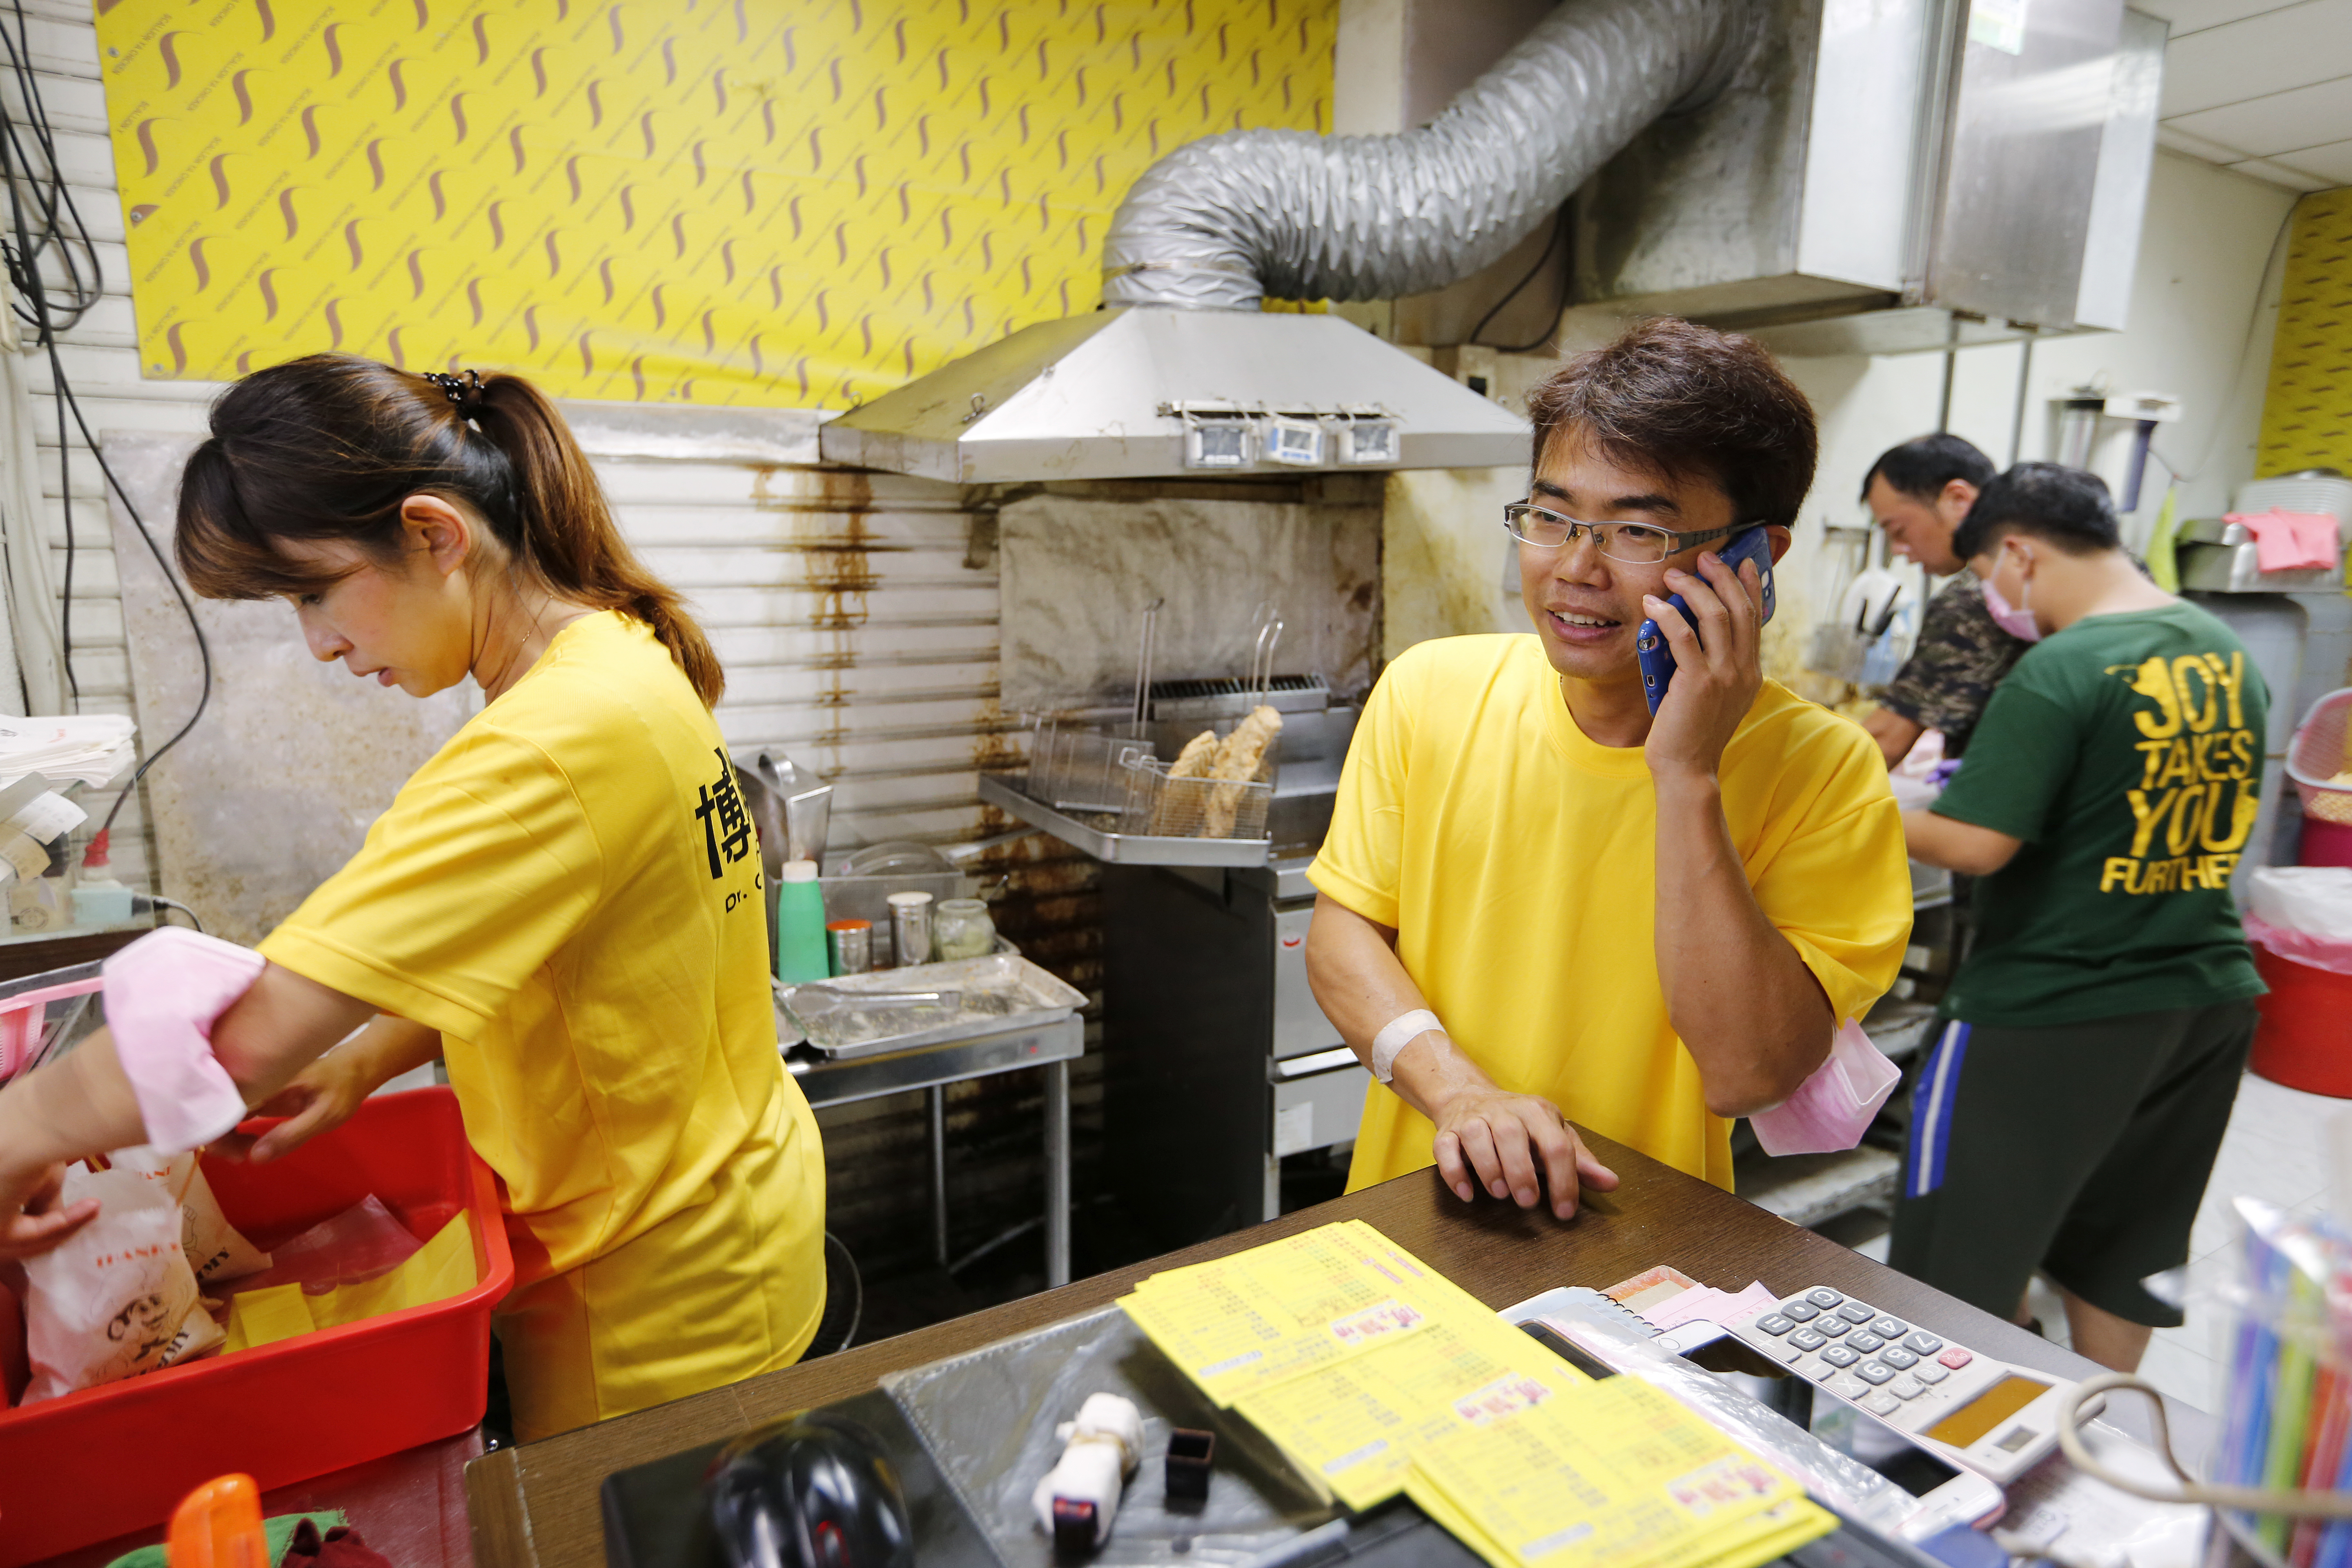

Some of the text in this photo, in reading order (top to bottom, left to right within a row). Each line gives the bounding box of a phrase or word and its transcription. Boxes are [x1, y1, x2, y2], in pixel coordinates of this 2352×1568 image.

[2130, 651, 2245, 739] JOY
[2134, 729, 2256, 791] TAKES
[2127, 778, 2260, 859] YOU
[726, 889, 747, 914] Dr.
[1845, 1307, 1865, 1316] 1
[1818, 1316, 1845, 1330] 2
[1875, 1320, 1896, 1332] 4
[1795, 1330, 1821, 1343] 3
[1853, 1331, 1877, 1345] 5
[1915, 1335, 1936, 1348] 7
[1886, 1348, 1912, 1361] 8
